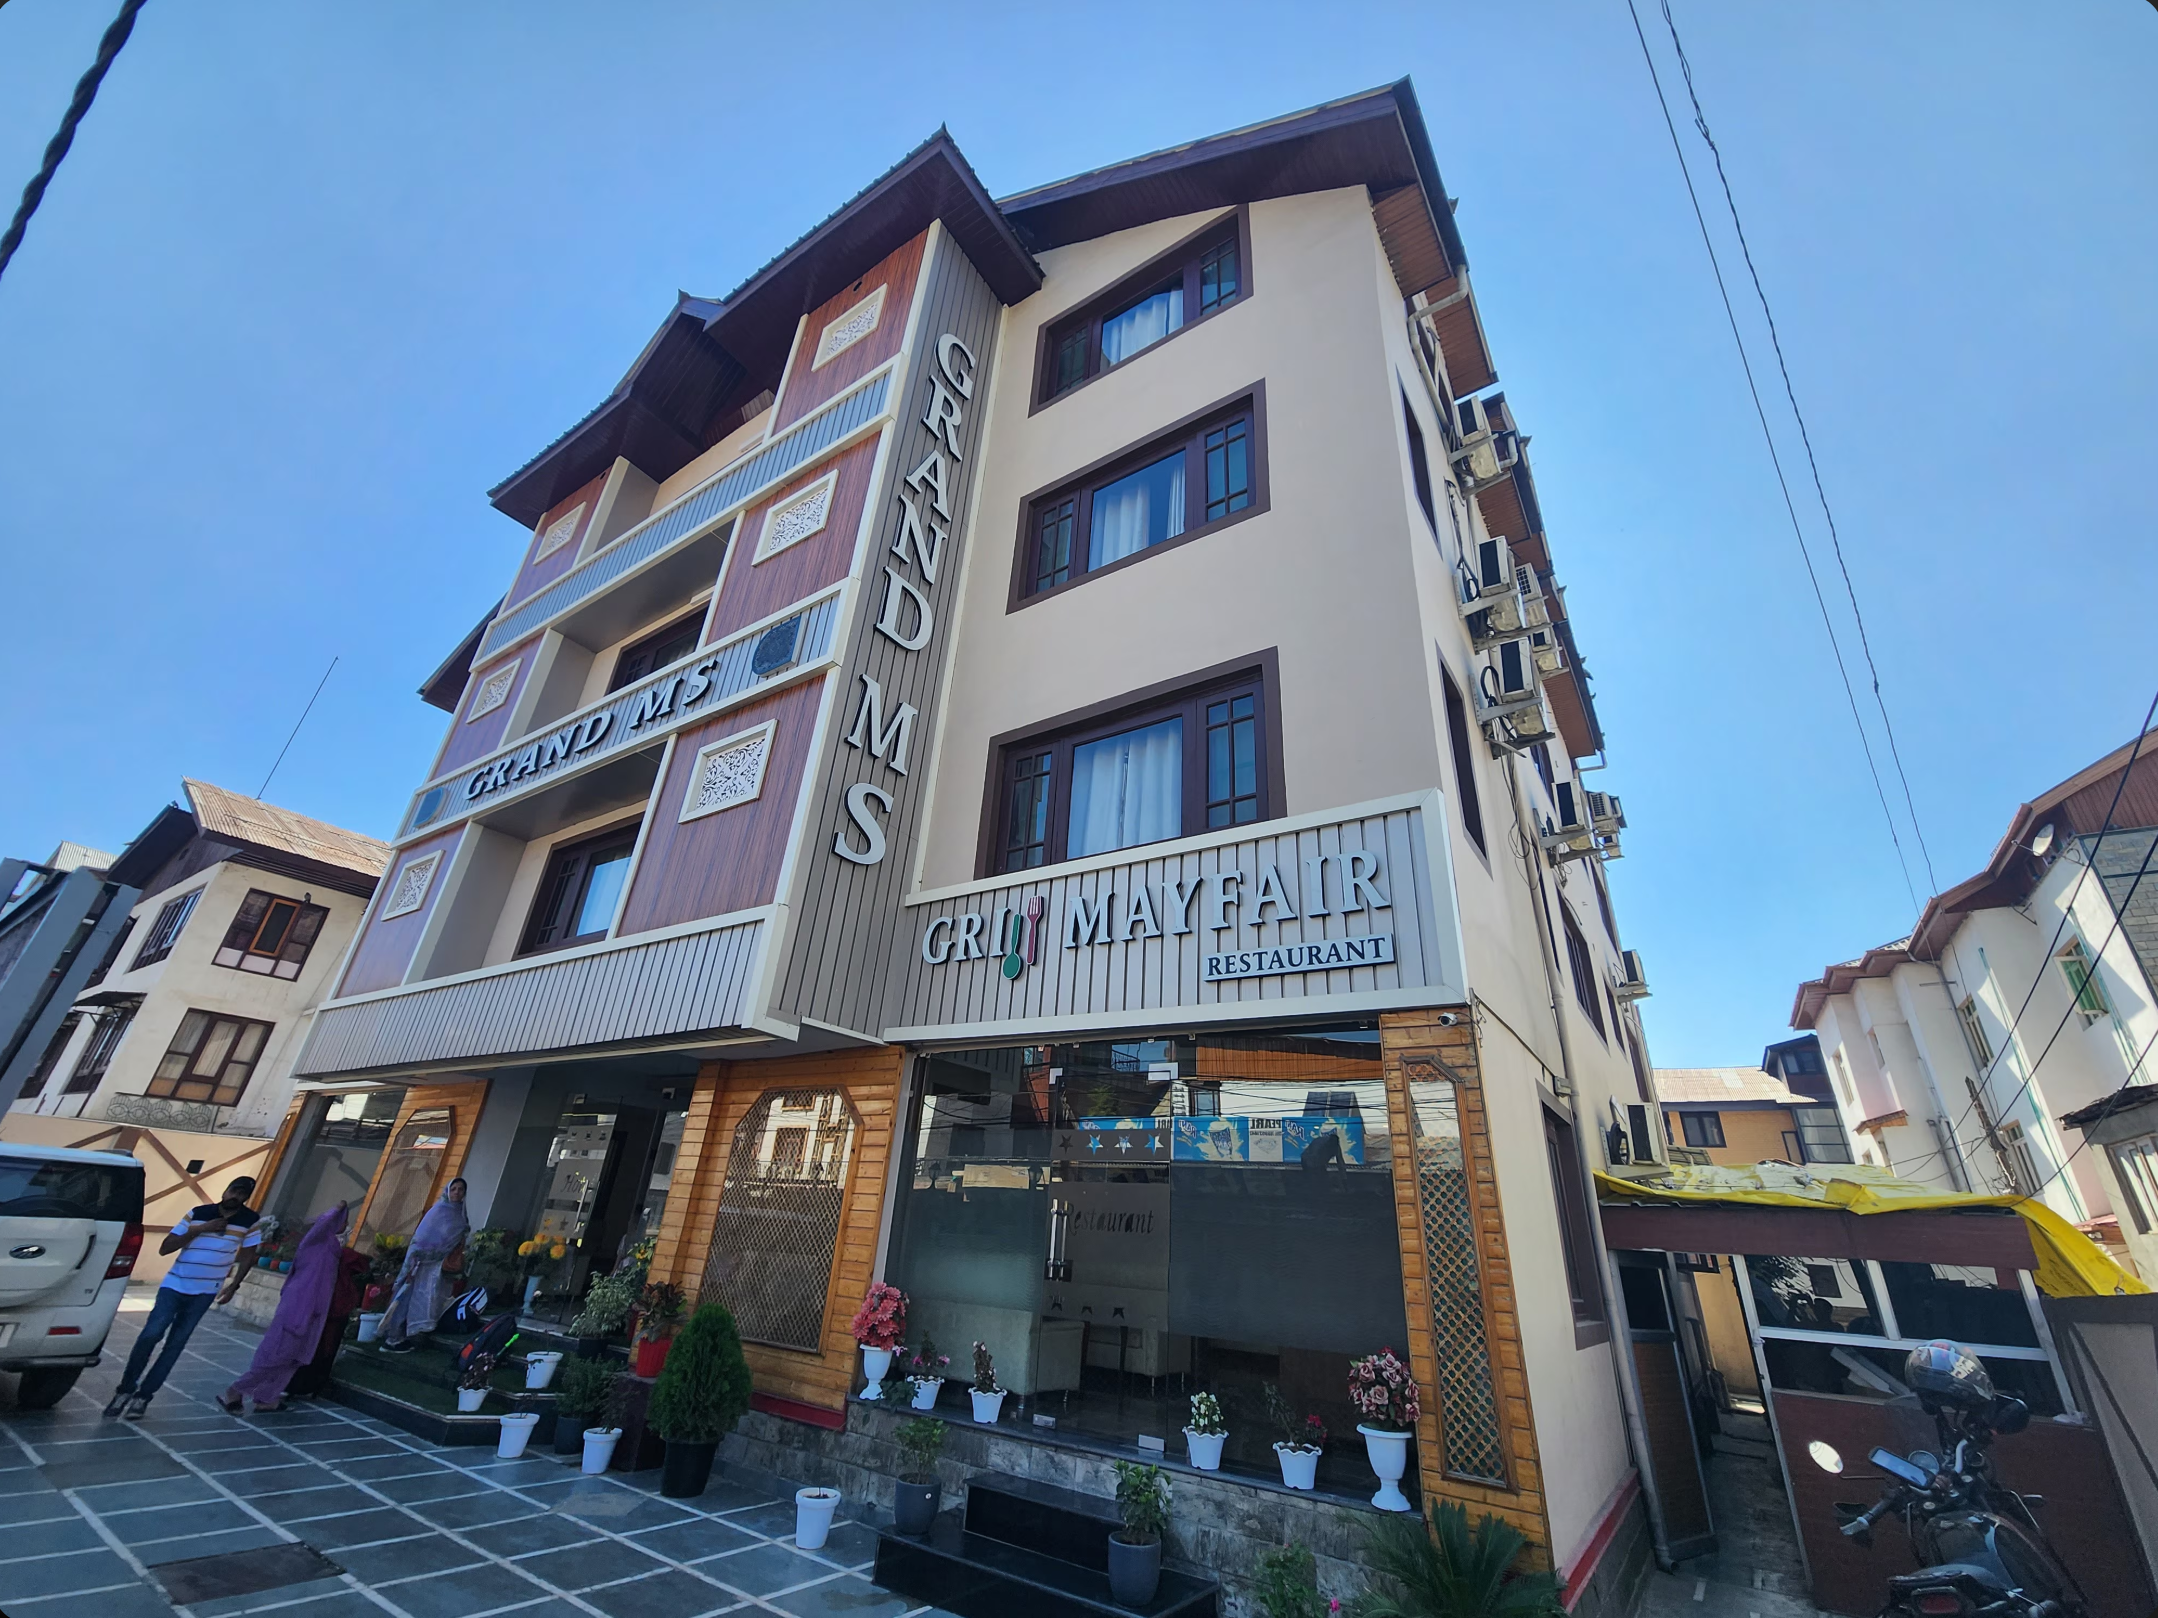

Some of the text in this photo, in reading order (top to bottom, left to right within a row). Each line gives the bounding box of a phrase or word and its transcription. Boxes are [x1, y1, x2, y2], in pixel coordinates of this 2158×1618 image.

[831, 333, 977, 865] GRAND MS
[464, 660, 718, 800] GRAND MS
[1063, 850, 1391, 949] MAYFAIR
[1206, 937, 1386, 977] RESTAURANT
